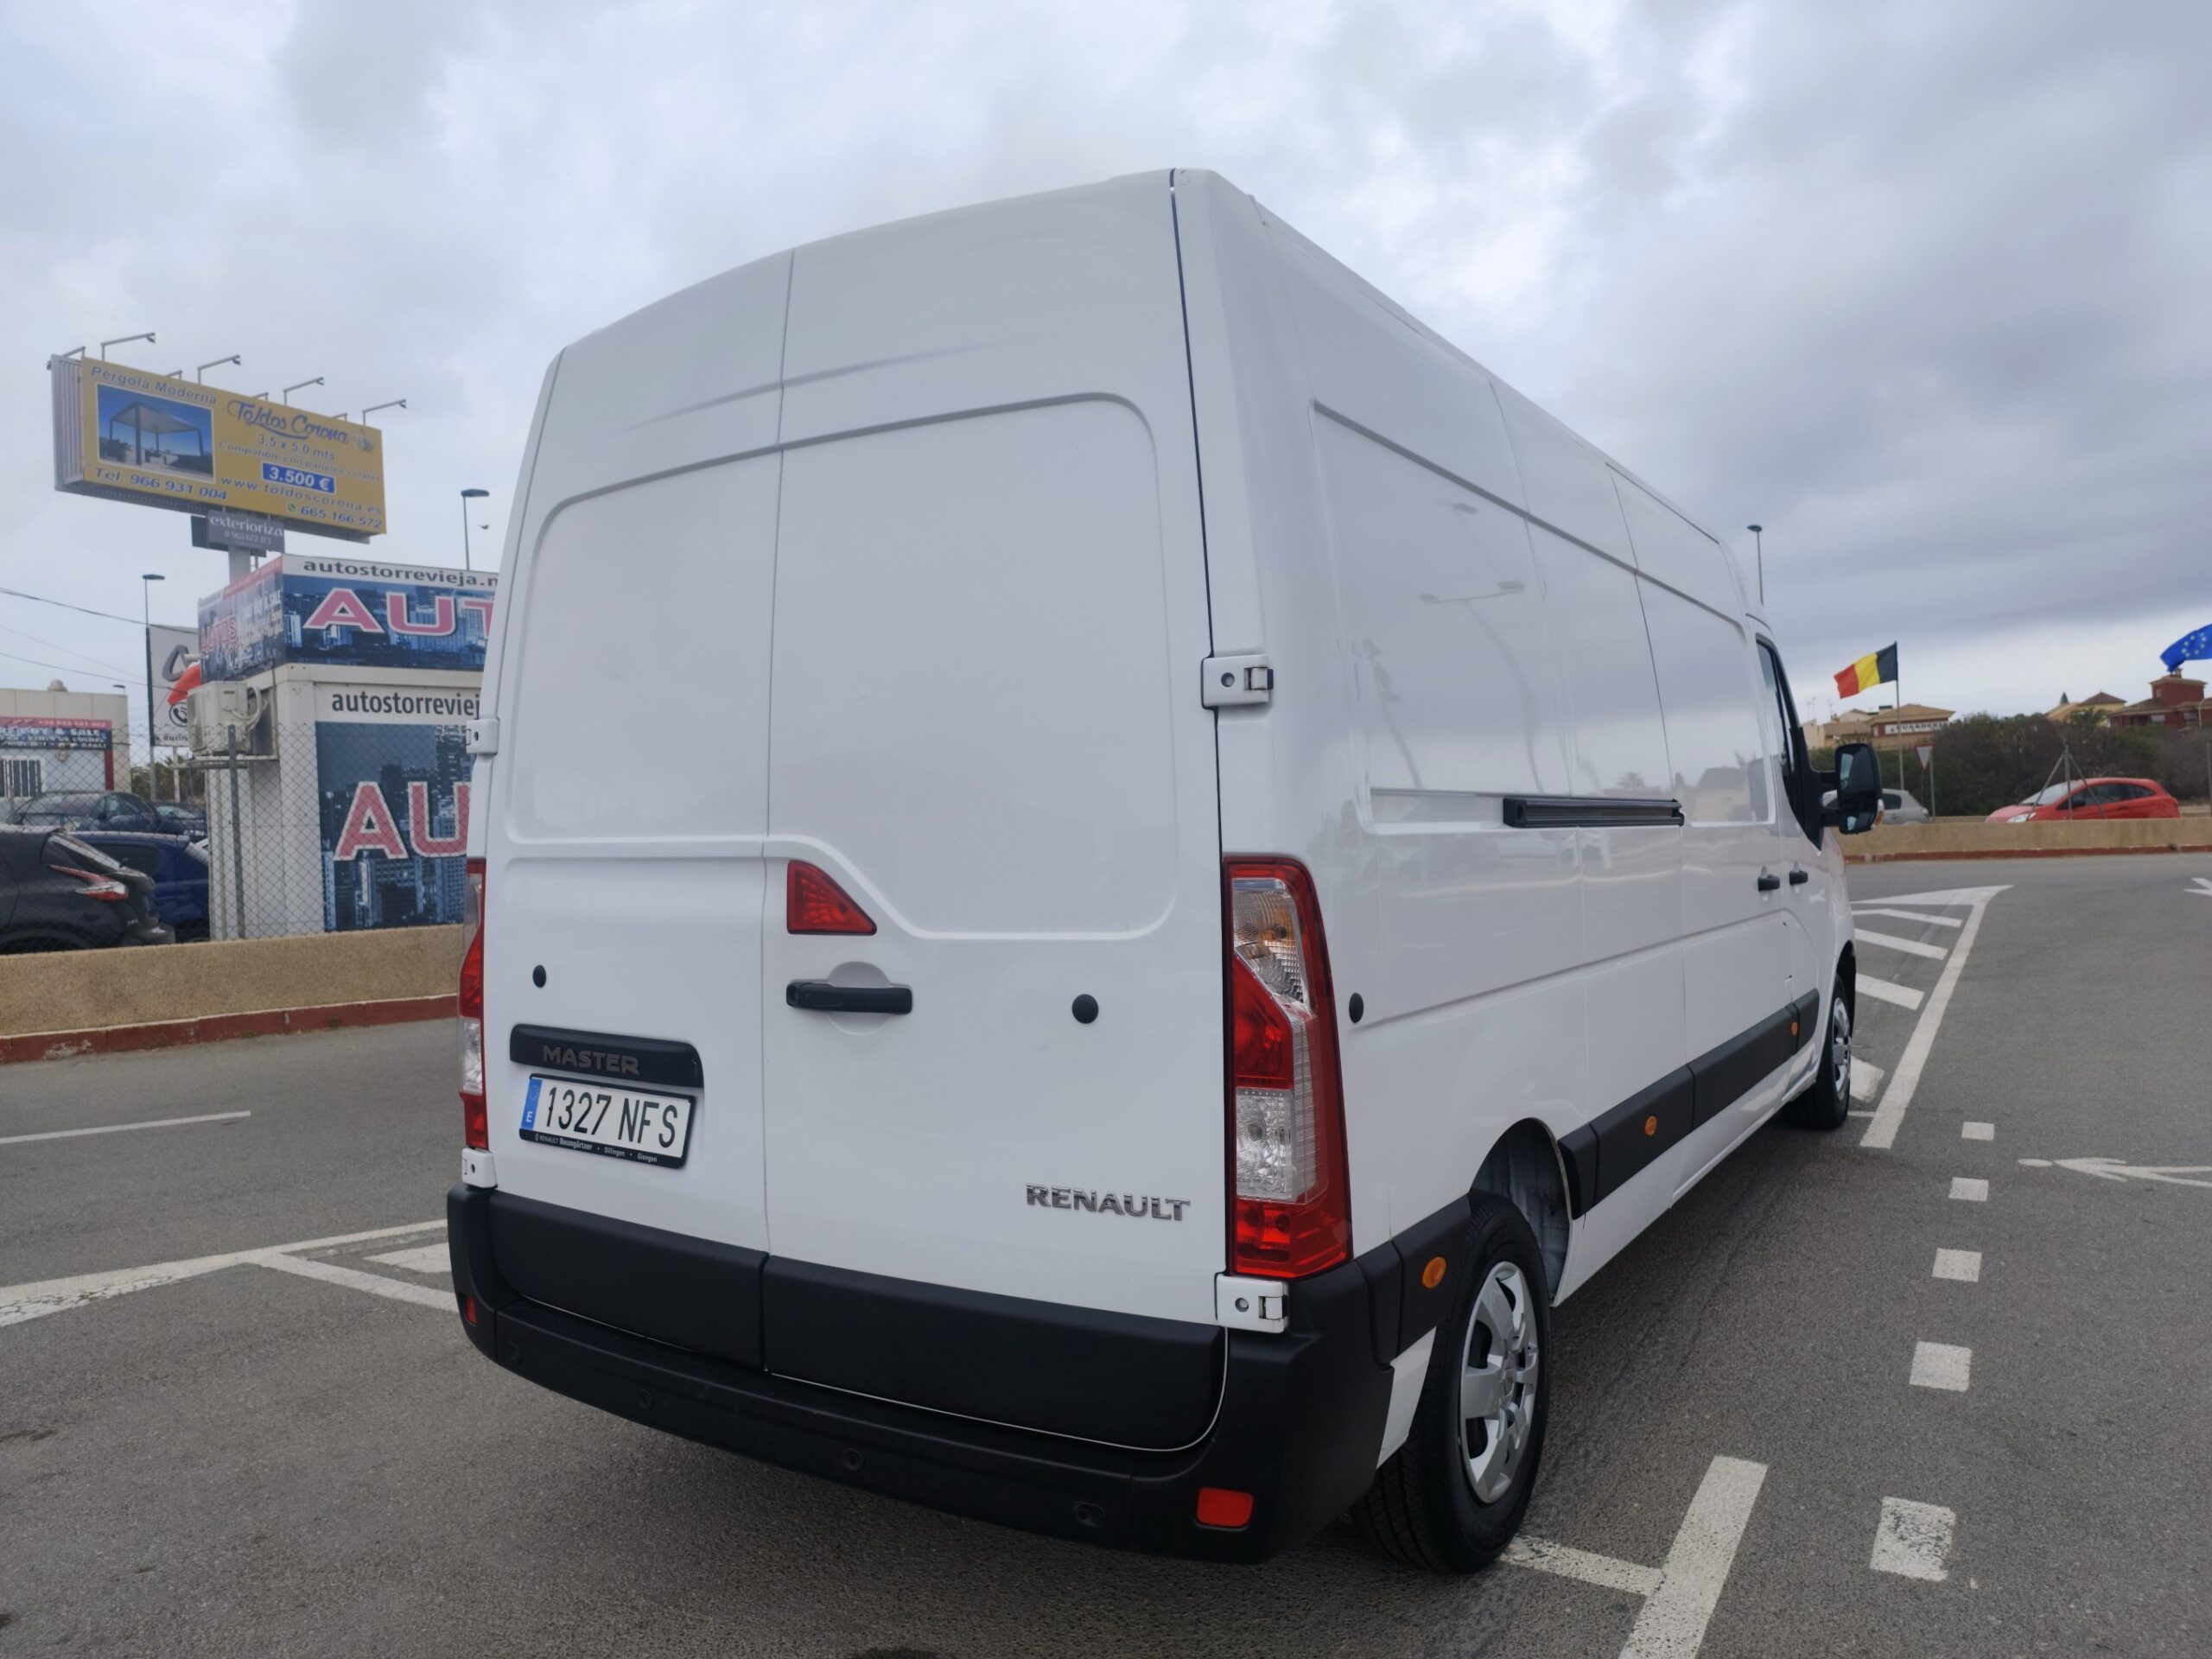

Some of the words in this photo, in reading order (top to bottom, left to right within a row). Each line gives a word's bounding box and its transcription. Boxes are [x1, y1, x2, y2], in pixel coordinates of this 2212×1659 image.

[92, 366, 149, 389] Pergola
[156, 381, 217, 404] Moderna
[227, 400, 287, 431] Toldos
[291, 415, 348, 444] Corona
[219, 441, 281, 461] Compatible
[283, 455, 303, 466] con
[130, 474, 160, 488] 966
[165, 480, 193, 493] 931
[199, 486, 227, 500] 004
[269, 467, 315, 486] 3.500
[319, 477, 330, 491] €
[300, 505, 327, 518] 665
[210, 514, 284, 537] exterioriza
[332, 781, 471, 861] AU
[543, 1045, 639, 1075] MASTER
[525, 1111, 533, 1122] E
[546, 1087, 612, 1135] 1327
[618, 1097, 678, 1148] NFS
[539, 1135, 558, 1143] RENAULT
[605, 1147, 626, 1157] Dillingen
[1026, 1183, 1192, 1221] RENAULT
